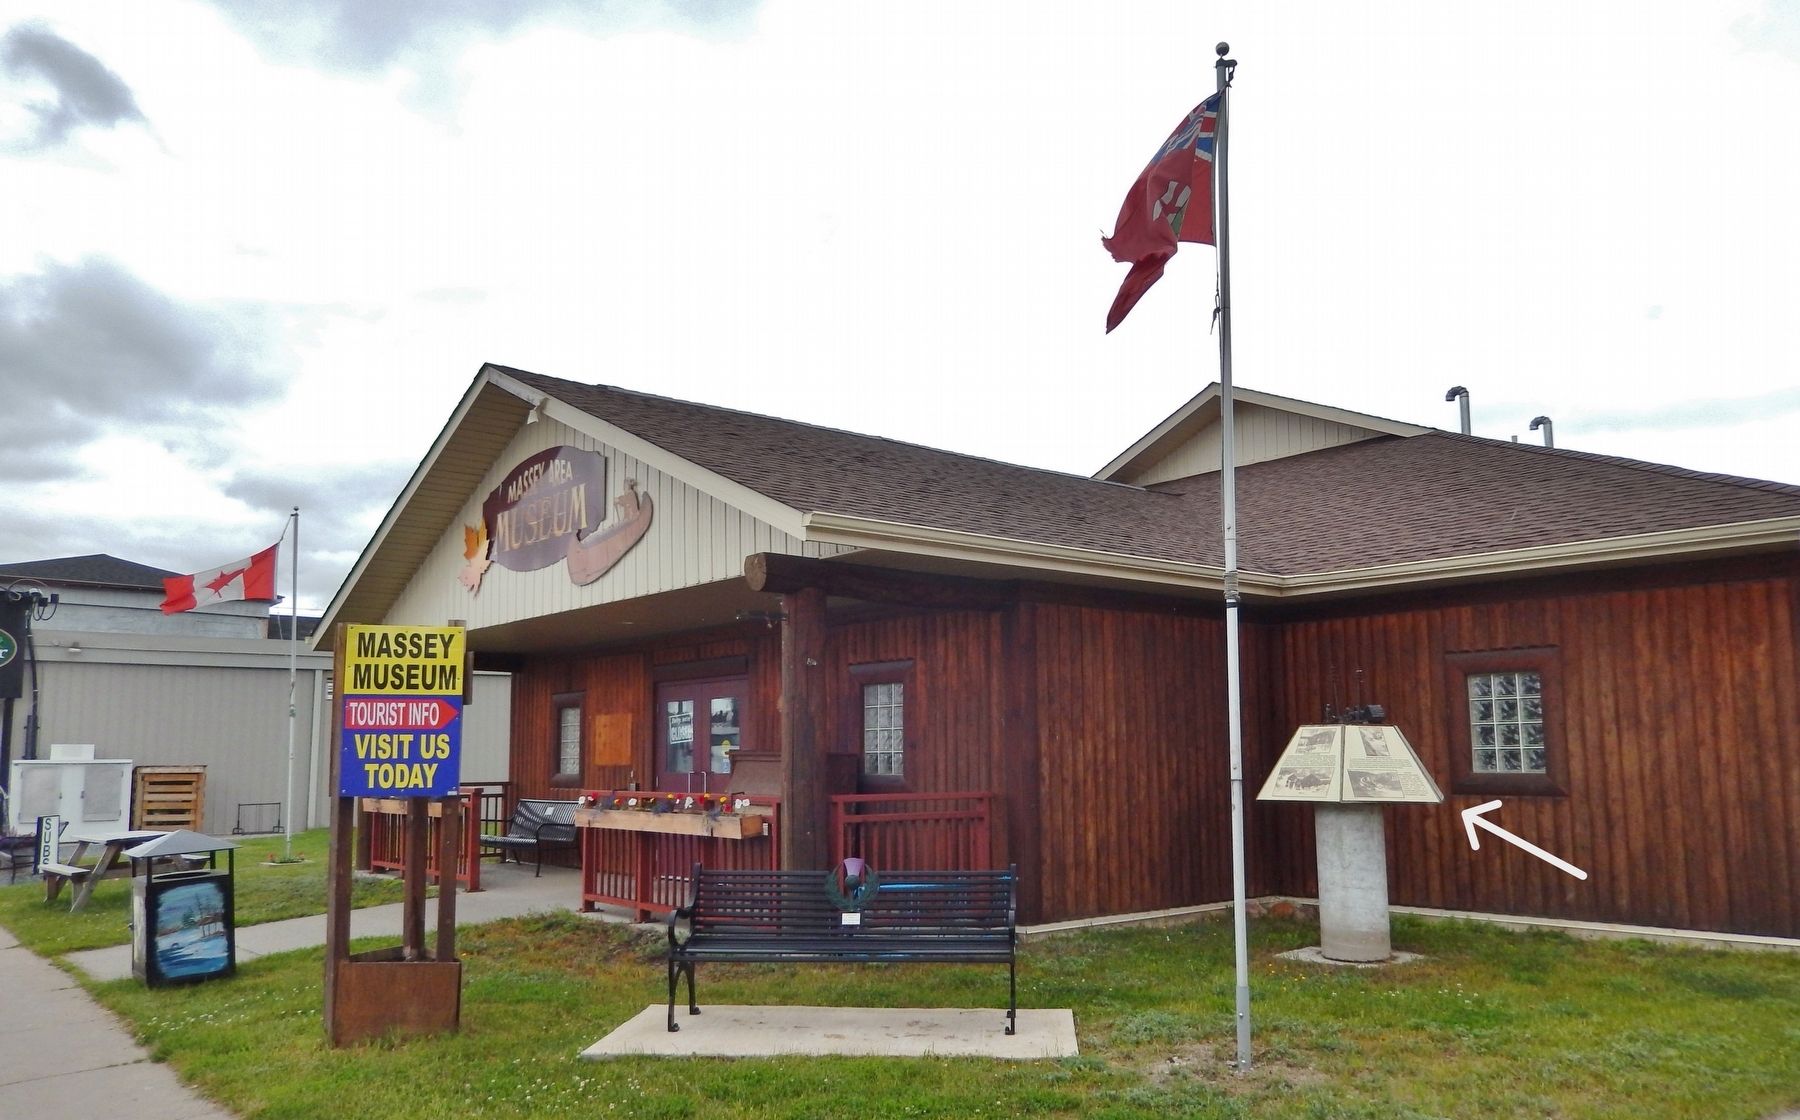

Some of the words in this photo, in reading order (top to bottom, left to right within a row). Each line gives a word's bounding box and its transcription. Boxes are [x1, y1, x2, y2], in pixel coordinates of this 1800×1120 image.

[507, 461, 545, 504] MASSEY
[548, 459, 574, 487] AREA
[495, 482, 588, 551] MUSEUM
[357, 632, 455, 658] MASSEY
[353, 663, 457, 690] MUSEUM
[350, 702, 406, 726] TOURIST
[409, 702, 439, 726] INFO
[354, 733, 414, 759] VISIT
[420, 733, 451, 760] US
[364, 763, 438, 789] TODAY
